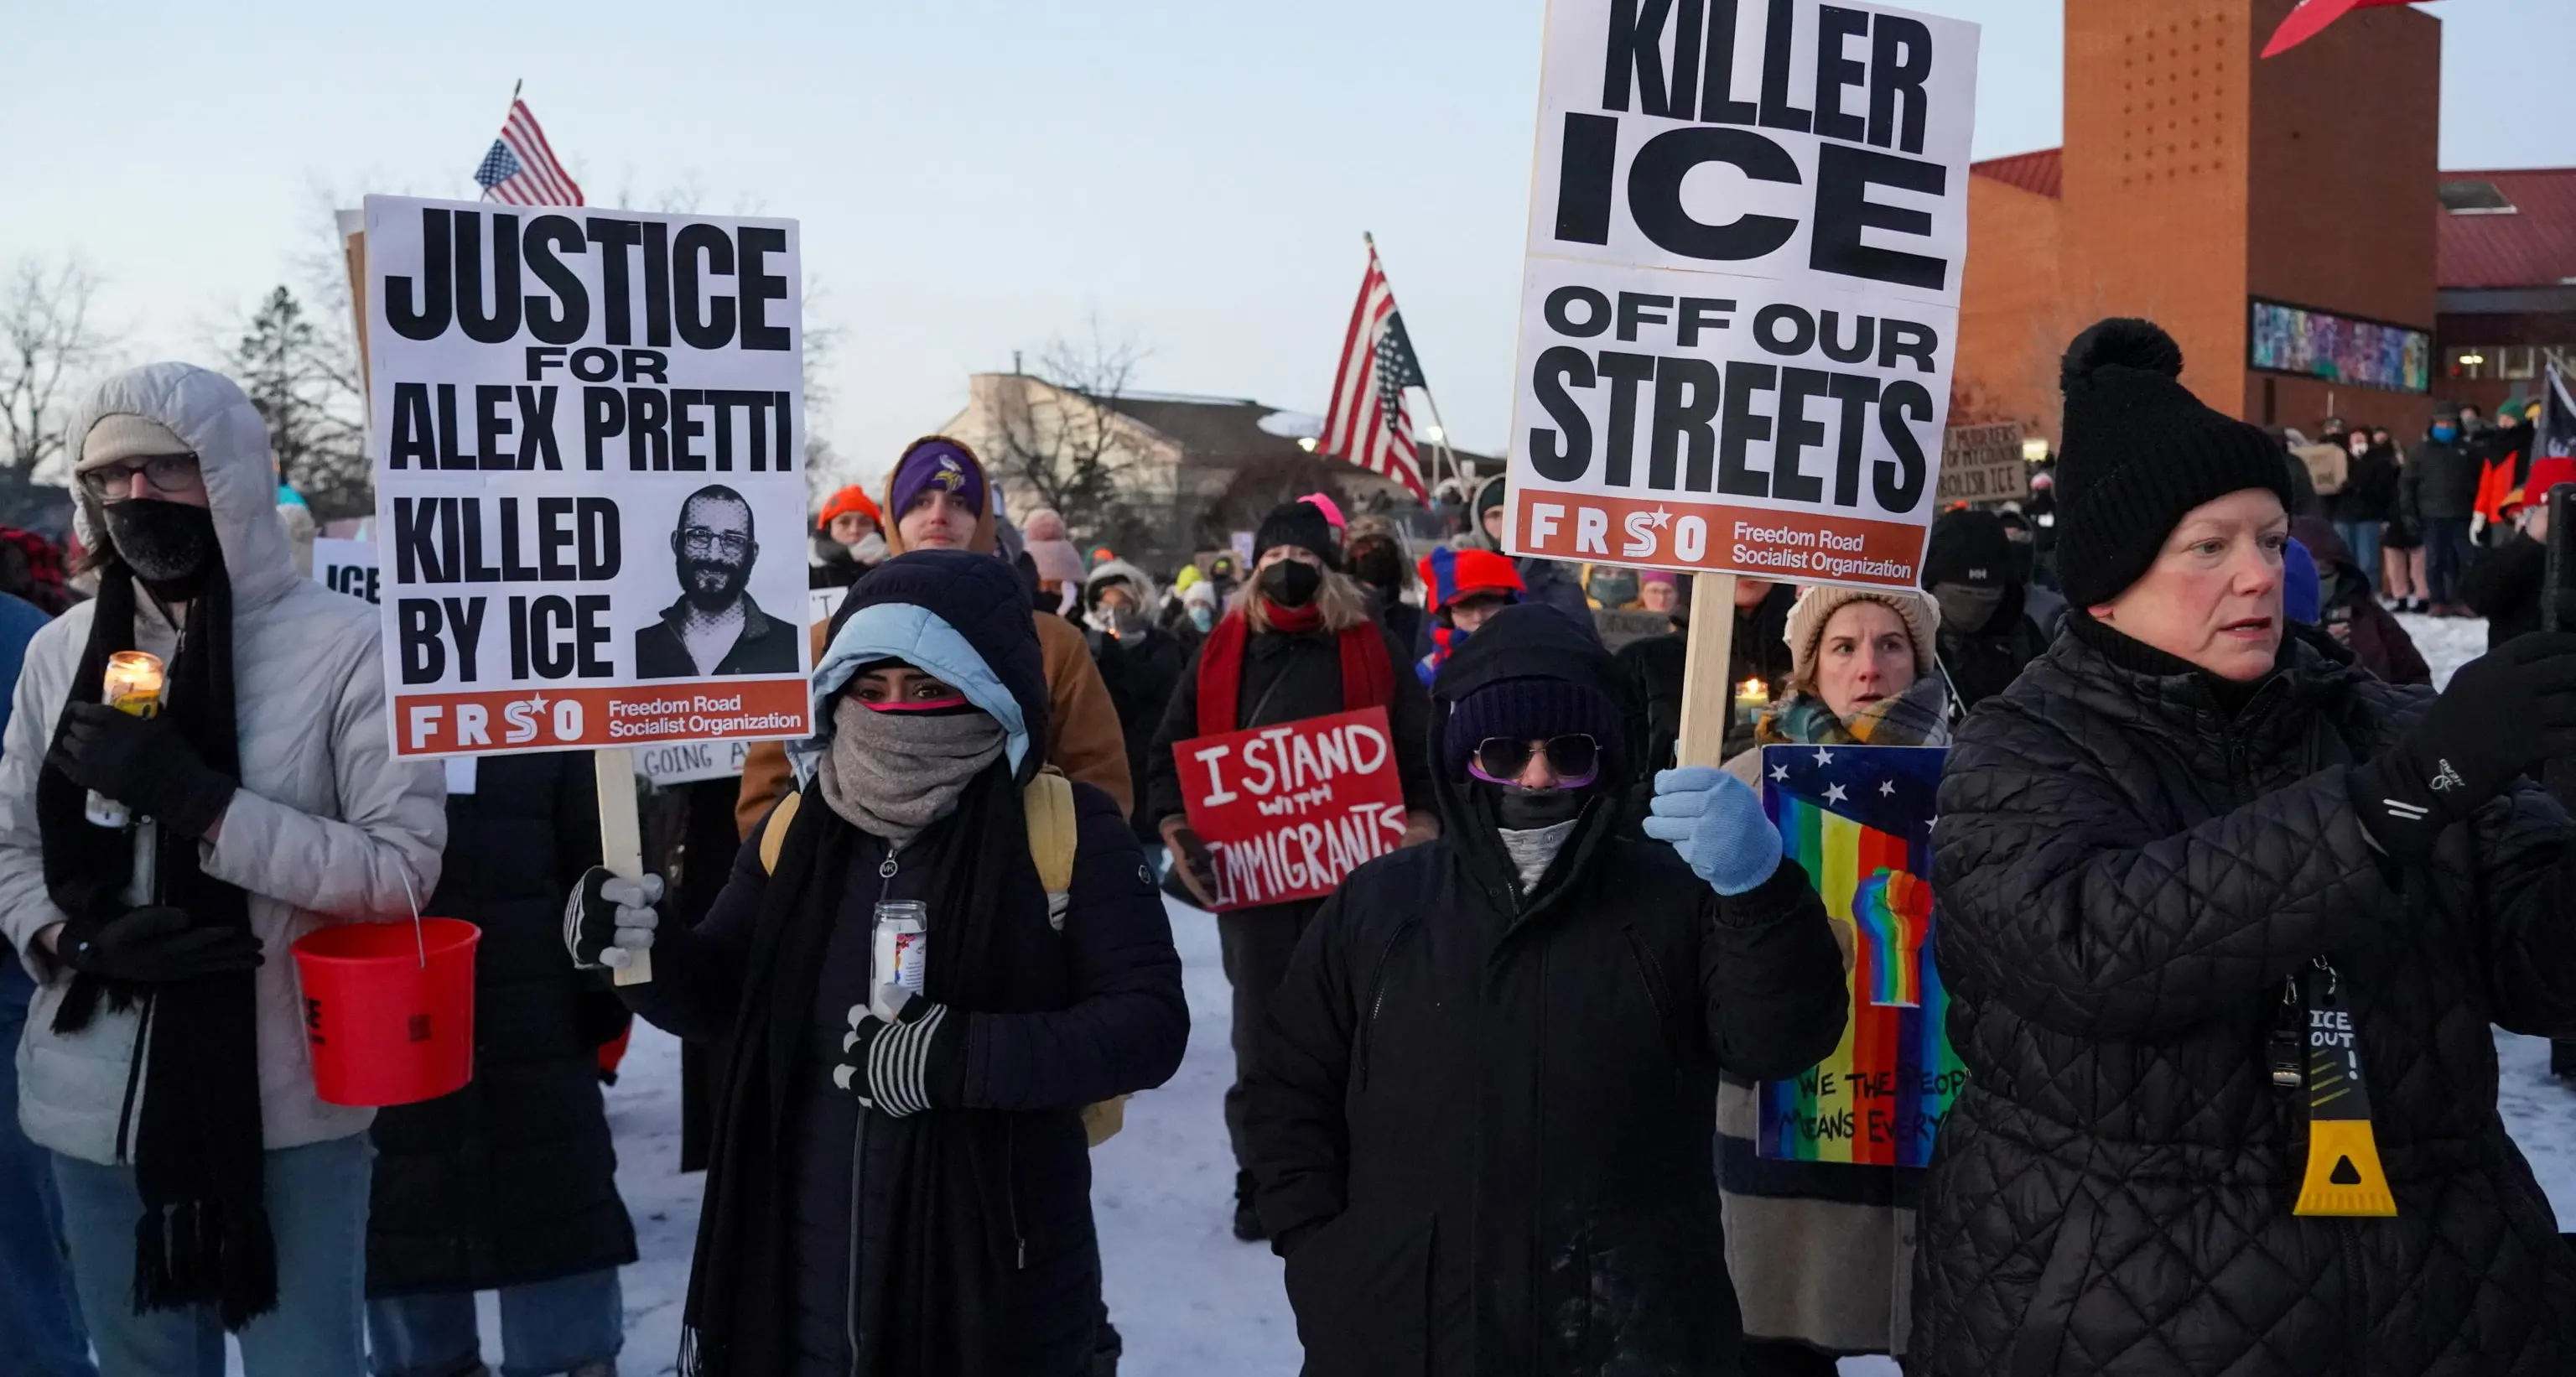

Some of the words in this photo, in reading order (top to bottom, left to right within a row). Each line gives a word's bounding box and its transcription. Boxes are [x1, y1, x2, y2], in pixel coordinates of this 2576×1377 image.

[1602, 0, 1932, 155] KILLER
[1554, 112, 1947, 290] ICE
[385, 208, 791, 351] JUSTICE
[1544, 285, 1737, 347] OFF
[1753, 303, 1938, 373] OUR
[526, 346, 668, 384] FOR
[390, 382, 563, 470] ALEX
[584, 386, 792, 471] PRETTI
[1529, 346, 1933, 514] STREETS
[393, 496, 621, 584] KILLED
[1732, 543, 1807, 569] Socialist
[1811, 552, 1911, 578] Organization
[1733, 522, 1815, 548] Freedom
[1820, 529, 1864, 552] Road
[398, 597, 487, 685] BY
[509, 595, 614, 680] ICE
[610, 699, 689, 717] Freedom
[695, 695, 740, 712] Road
[610, 719, 686, 738] Socialist
[689, 713, 801, 735] Organization
[644, 743, 712, 777] GOING
[1195, 746, 1238, 808] I
[1241, 724, 1388, 796] STAND
[1203, 803, 1407, 907] IMMIGRANTS
[2309, 1009, 2352, 1031] ICE
[2310, 1031, 2355, 1048] OUT
[1797, 1065, 1836, 1100] WE
[1845, 1070, 1897, 1100] THE
[1898, 1063, 1966, 1101] PEOP
[1779, 1108, 1856, 1142] MEANS
[1868, 1109, 1948, 1143] EVERY
